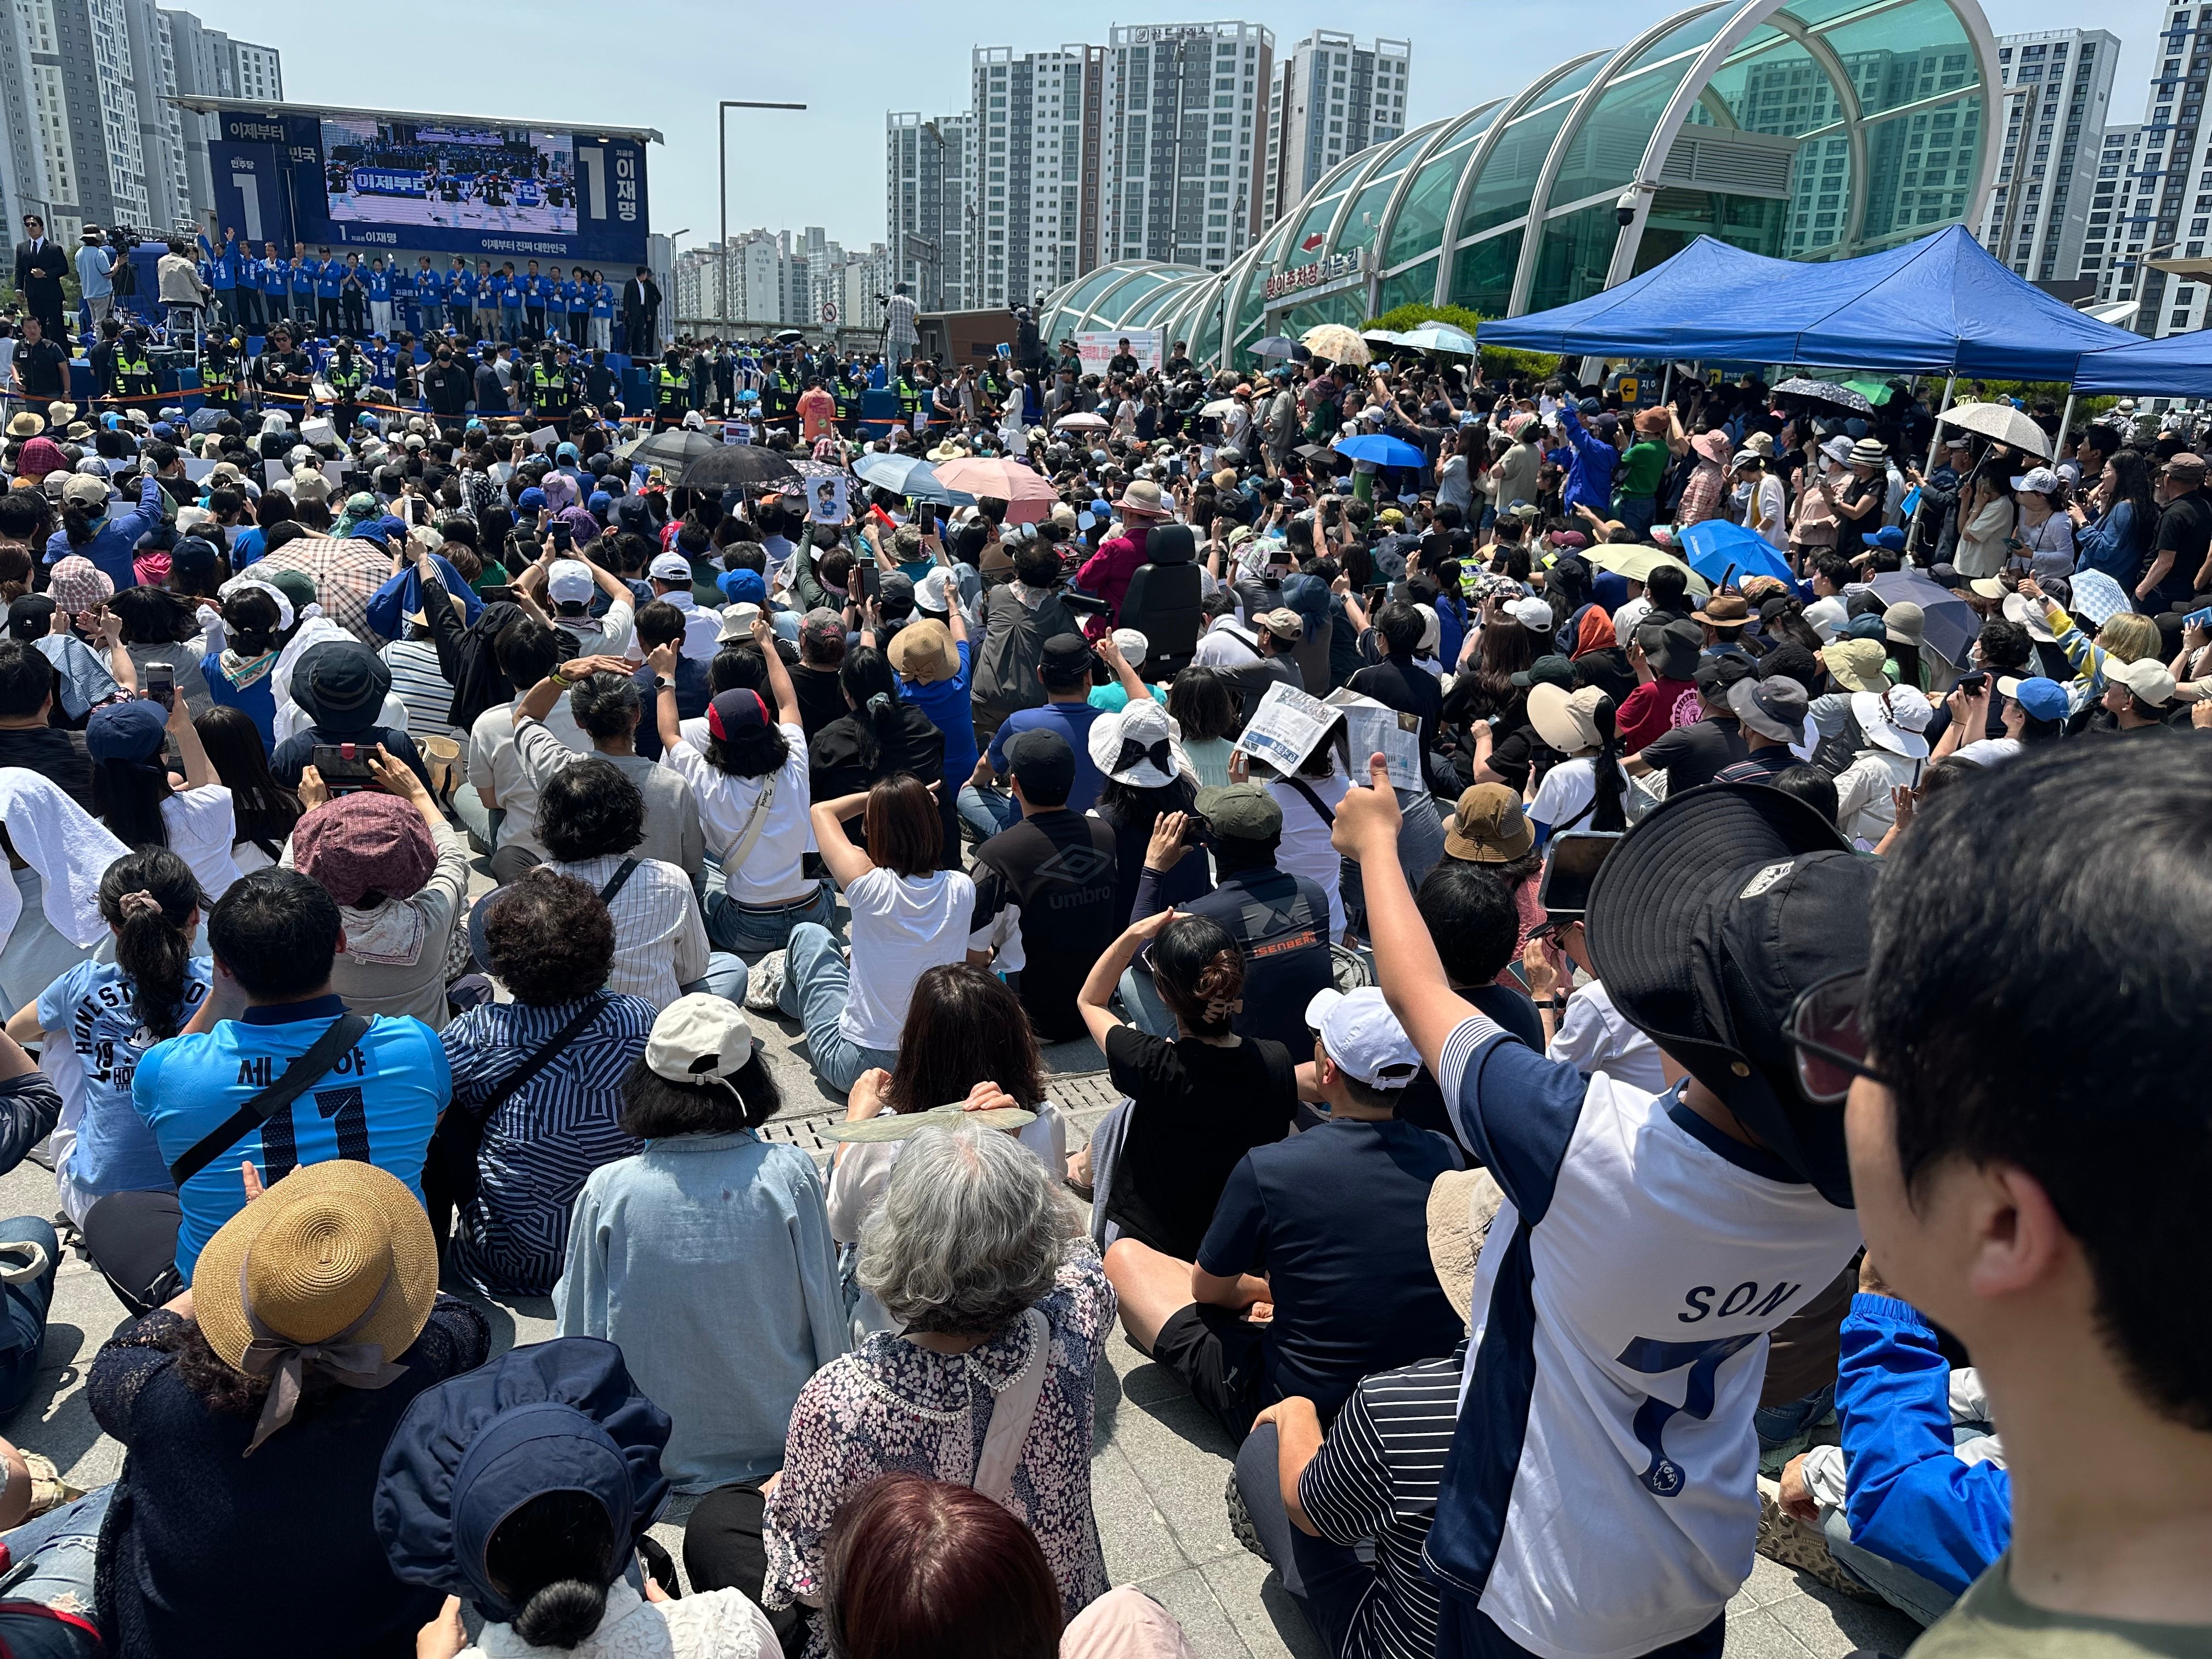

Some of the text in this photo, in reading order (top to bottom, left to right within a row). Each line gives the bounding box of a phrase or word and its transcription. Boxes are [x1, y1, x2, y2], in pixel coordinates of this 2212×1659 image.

[230, 122, 285, 142] 이제부터
[230, 159, 254, 169] 민주당
[616, 149, 634, 158] 지금은
[579, 146, 607, 219] 1
[616, 159, 636, 222] 이재명
[232, 173, 263, 241] 1
[338, 224, 347, 241] 1
[365, 231, 397, 244] 이재명
[482, 239, 567, 255] 이제부터 진짜 대한민국
[1267, 262, 1318, 298] 맞이주차장
[1049, 886, 1111, 910] umbro
[237, 1046, 366, 1088] 세야
[240, 1086, 372, 1189] 11
[1678, 1281, 1802, 1323] SON
[1615, 1331, 1772, 1498] 7
